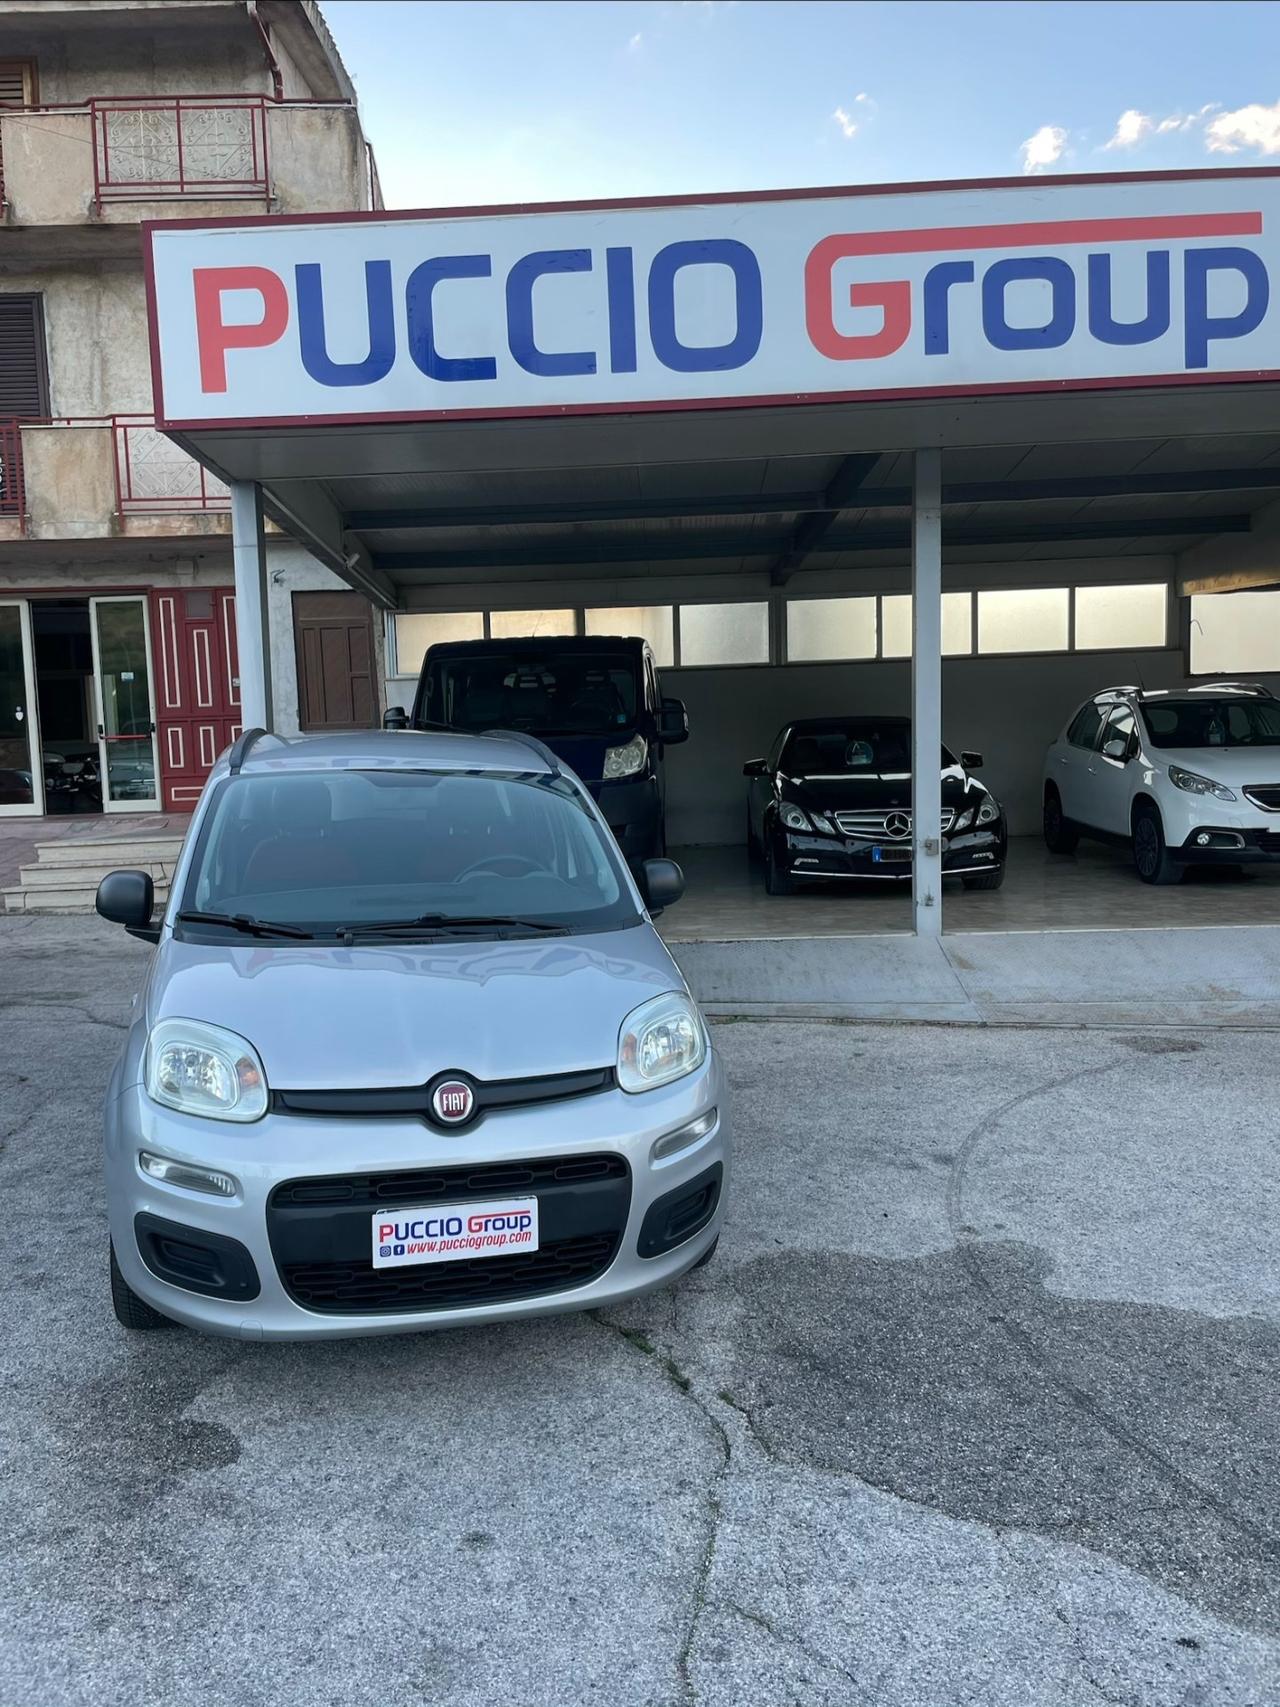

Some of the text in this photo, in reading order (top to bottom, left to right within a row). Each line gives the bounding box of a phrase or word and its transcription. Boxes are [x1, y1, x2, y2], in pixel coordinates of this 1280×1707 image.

[192, 210, 1270, 394] PUCCIO Group
[442, 1092, 466, 1112] FIAT
[379, 1210, 532, 1243] PUCCIO Group
[407, 1231, 532, 1254] www.pucciogroup.com
